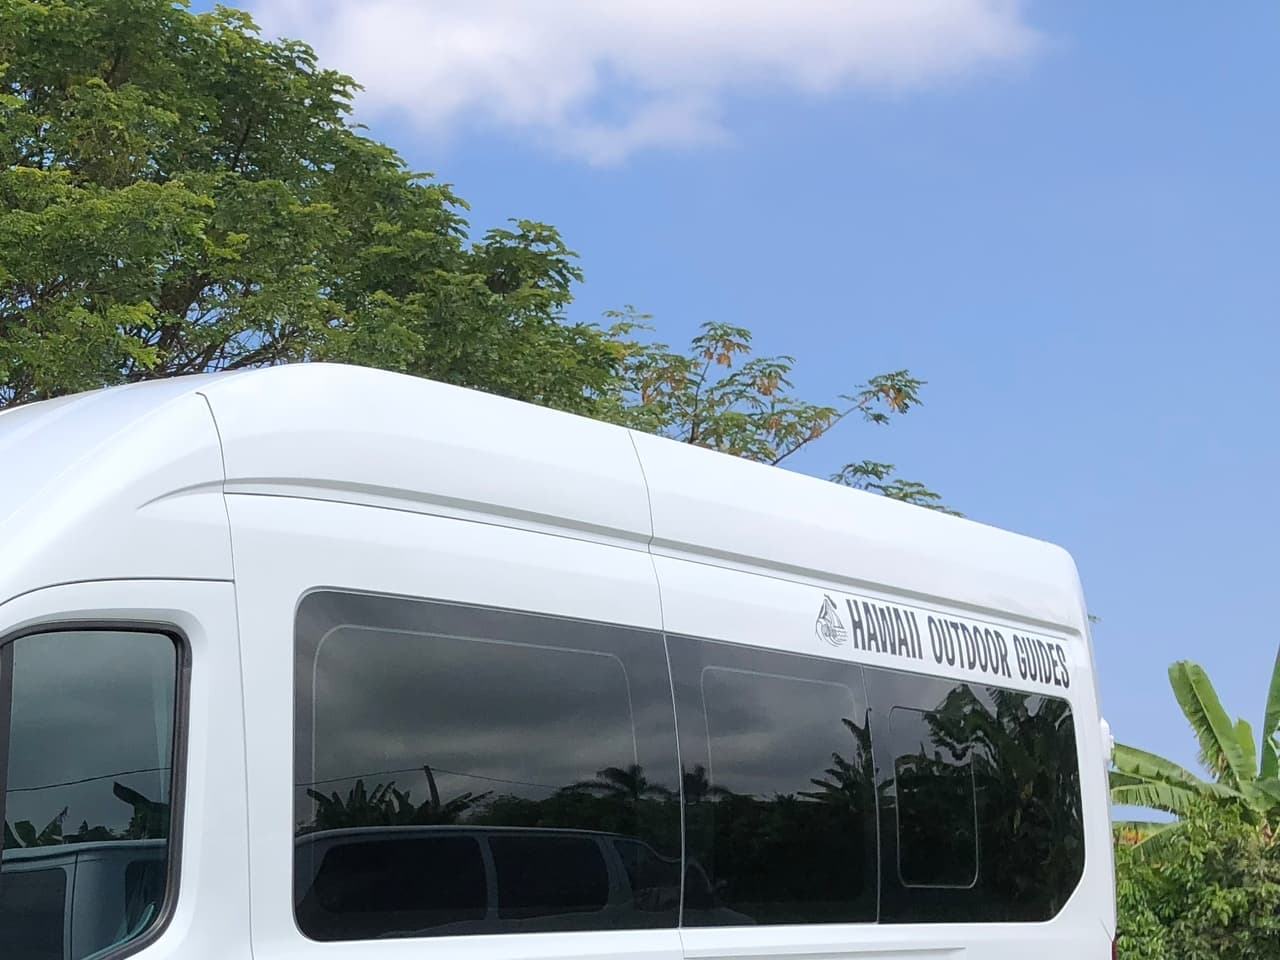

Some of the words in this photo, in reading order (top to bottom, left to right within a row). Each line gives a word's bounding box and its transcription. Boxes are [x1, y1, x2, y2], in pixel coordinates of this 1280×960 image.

[845, 599, 924, 660] HAWAII
[927, 615, 1012, 678] OUTDOOR
[1012, 635, 1070, 688] GUIDES
